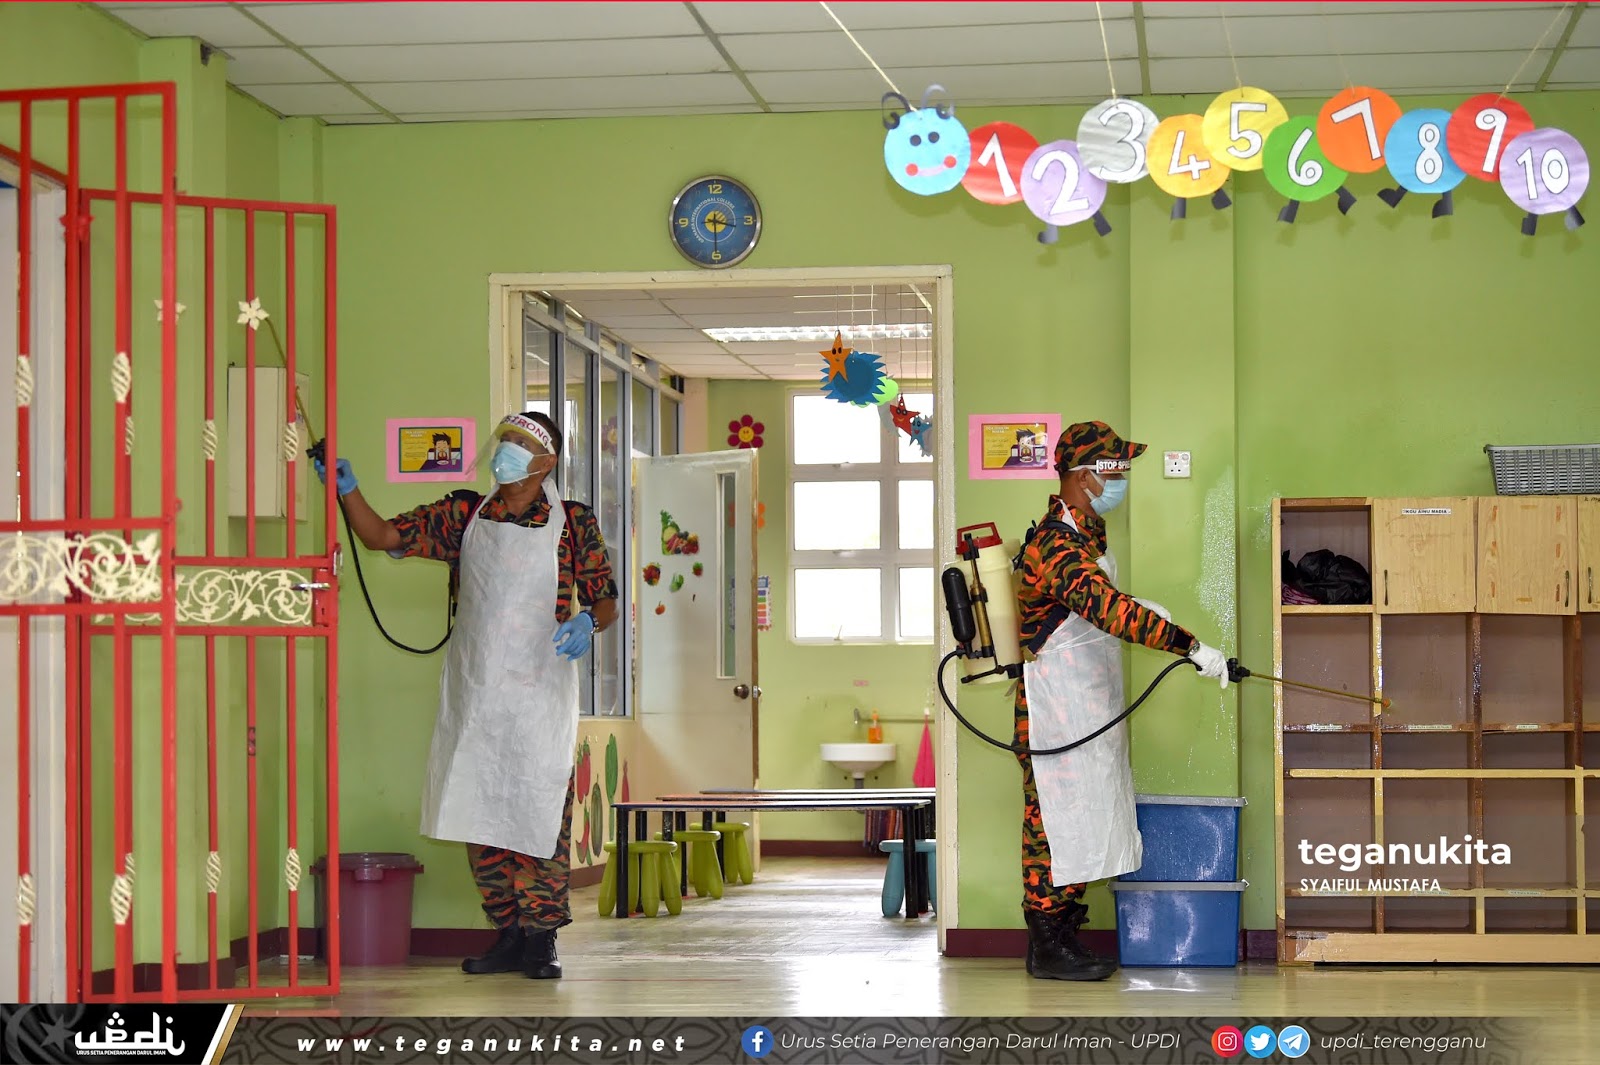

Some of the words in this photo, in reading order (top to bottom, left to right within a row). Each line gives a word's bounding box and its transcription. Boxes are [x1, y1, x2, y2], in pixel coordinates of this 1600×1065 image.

[1099, 102, 1146, 180] 3
[1168, 131, 1211, 180] 4
[1226, 101, 1268, 159] 5
[1331, 97, 1383, 161] 7
[1415, 123, 1443, 184] 8
[1475, 108, 1508, 173] 9
[978, 133, 1018, 198] 1
[1032, 150, 1090, 216] 2
[1287, 128, 1323, 186] 6
[1516, 147, 1570, 200] 10
[707, 184, 723, 194] 12
[678, 217, 689, 228] 9
[743, 215, 753, 226] 3
[711, 250, 721, 260] 6
[504, 415, 549, 447] STRONG
[1099, 461, 1117, 470] STOP
